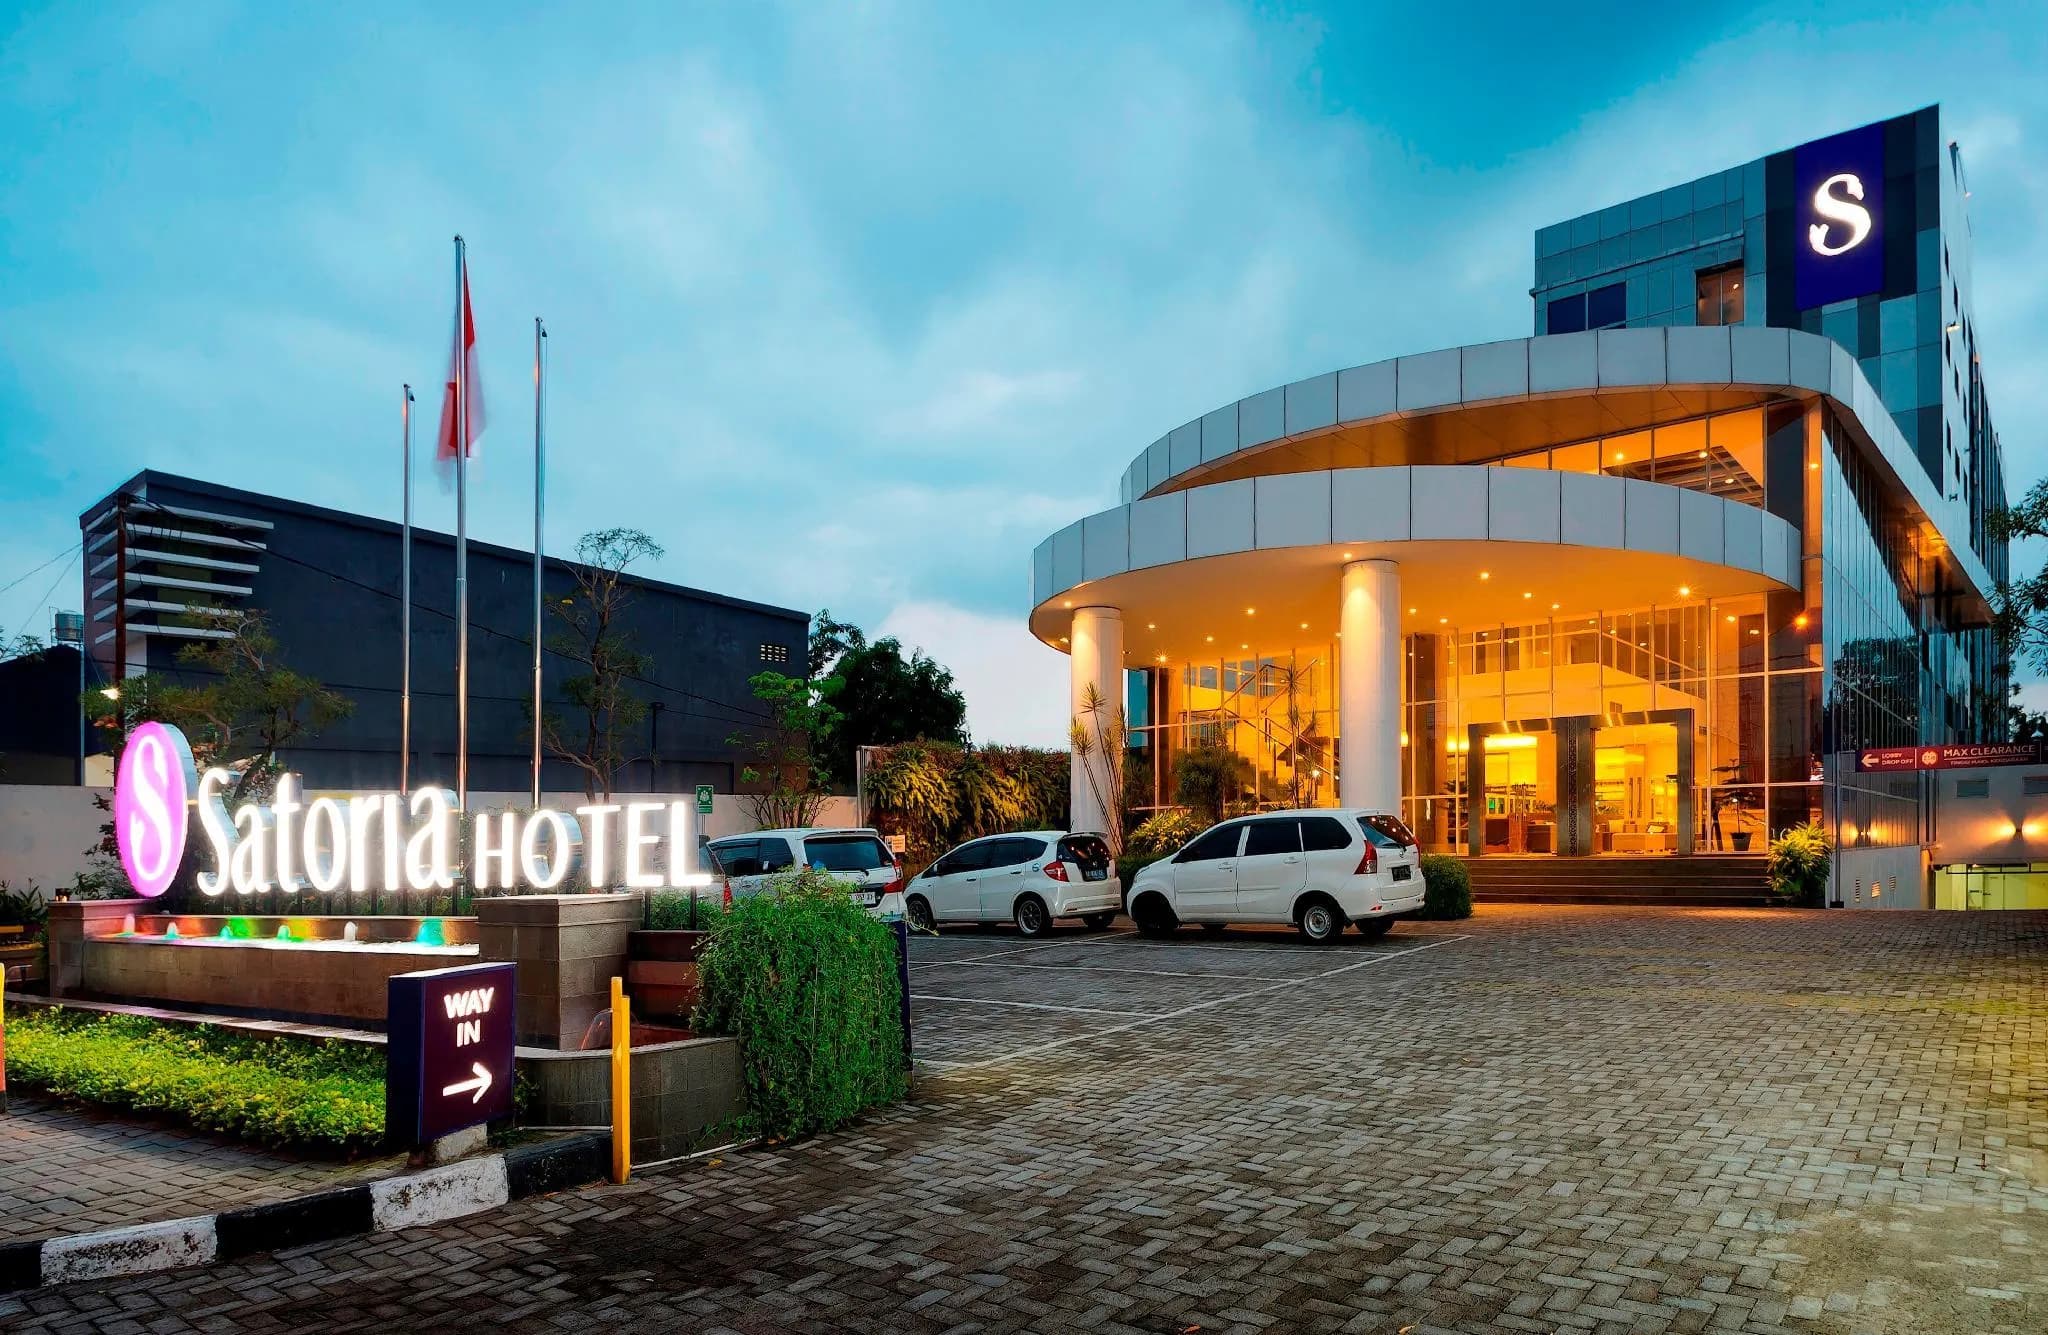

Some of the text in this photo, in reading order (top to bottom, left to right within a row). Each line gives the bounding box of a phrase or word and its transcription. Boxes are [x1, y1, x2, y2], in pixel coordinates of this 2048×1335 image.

[1809, 173, 1872, 256] S
[1943, 744, 2036, 757] MAX CLEARANCE
[197, 766, 713, 897] Satoria HOTEL
[443, 987, 495, 1019] WAY
[456, 1019, 481, 1048] IN
